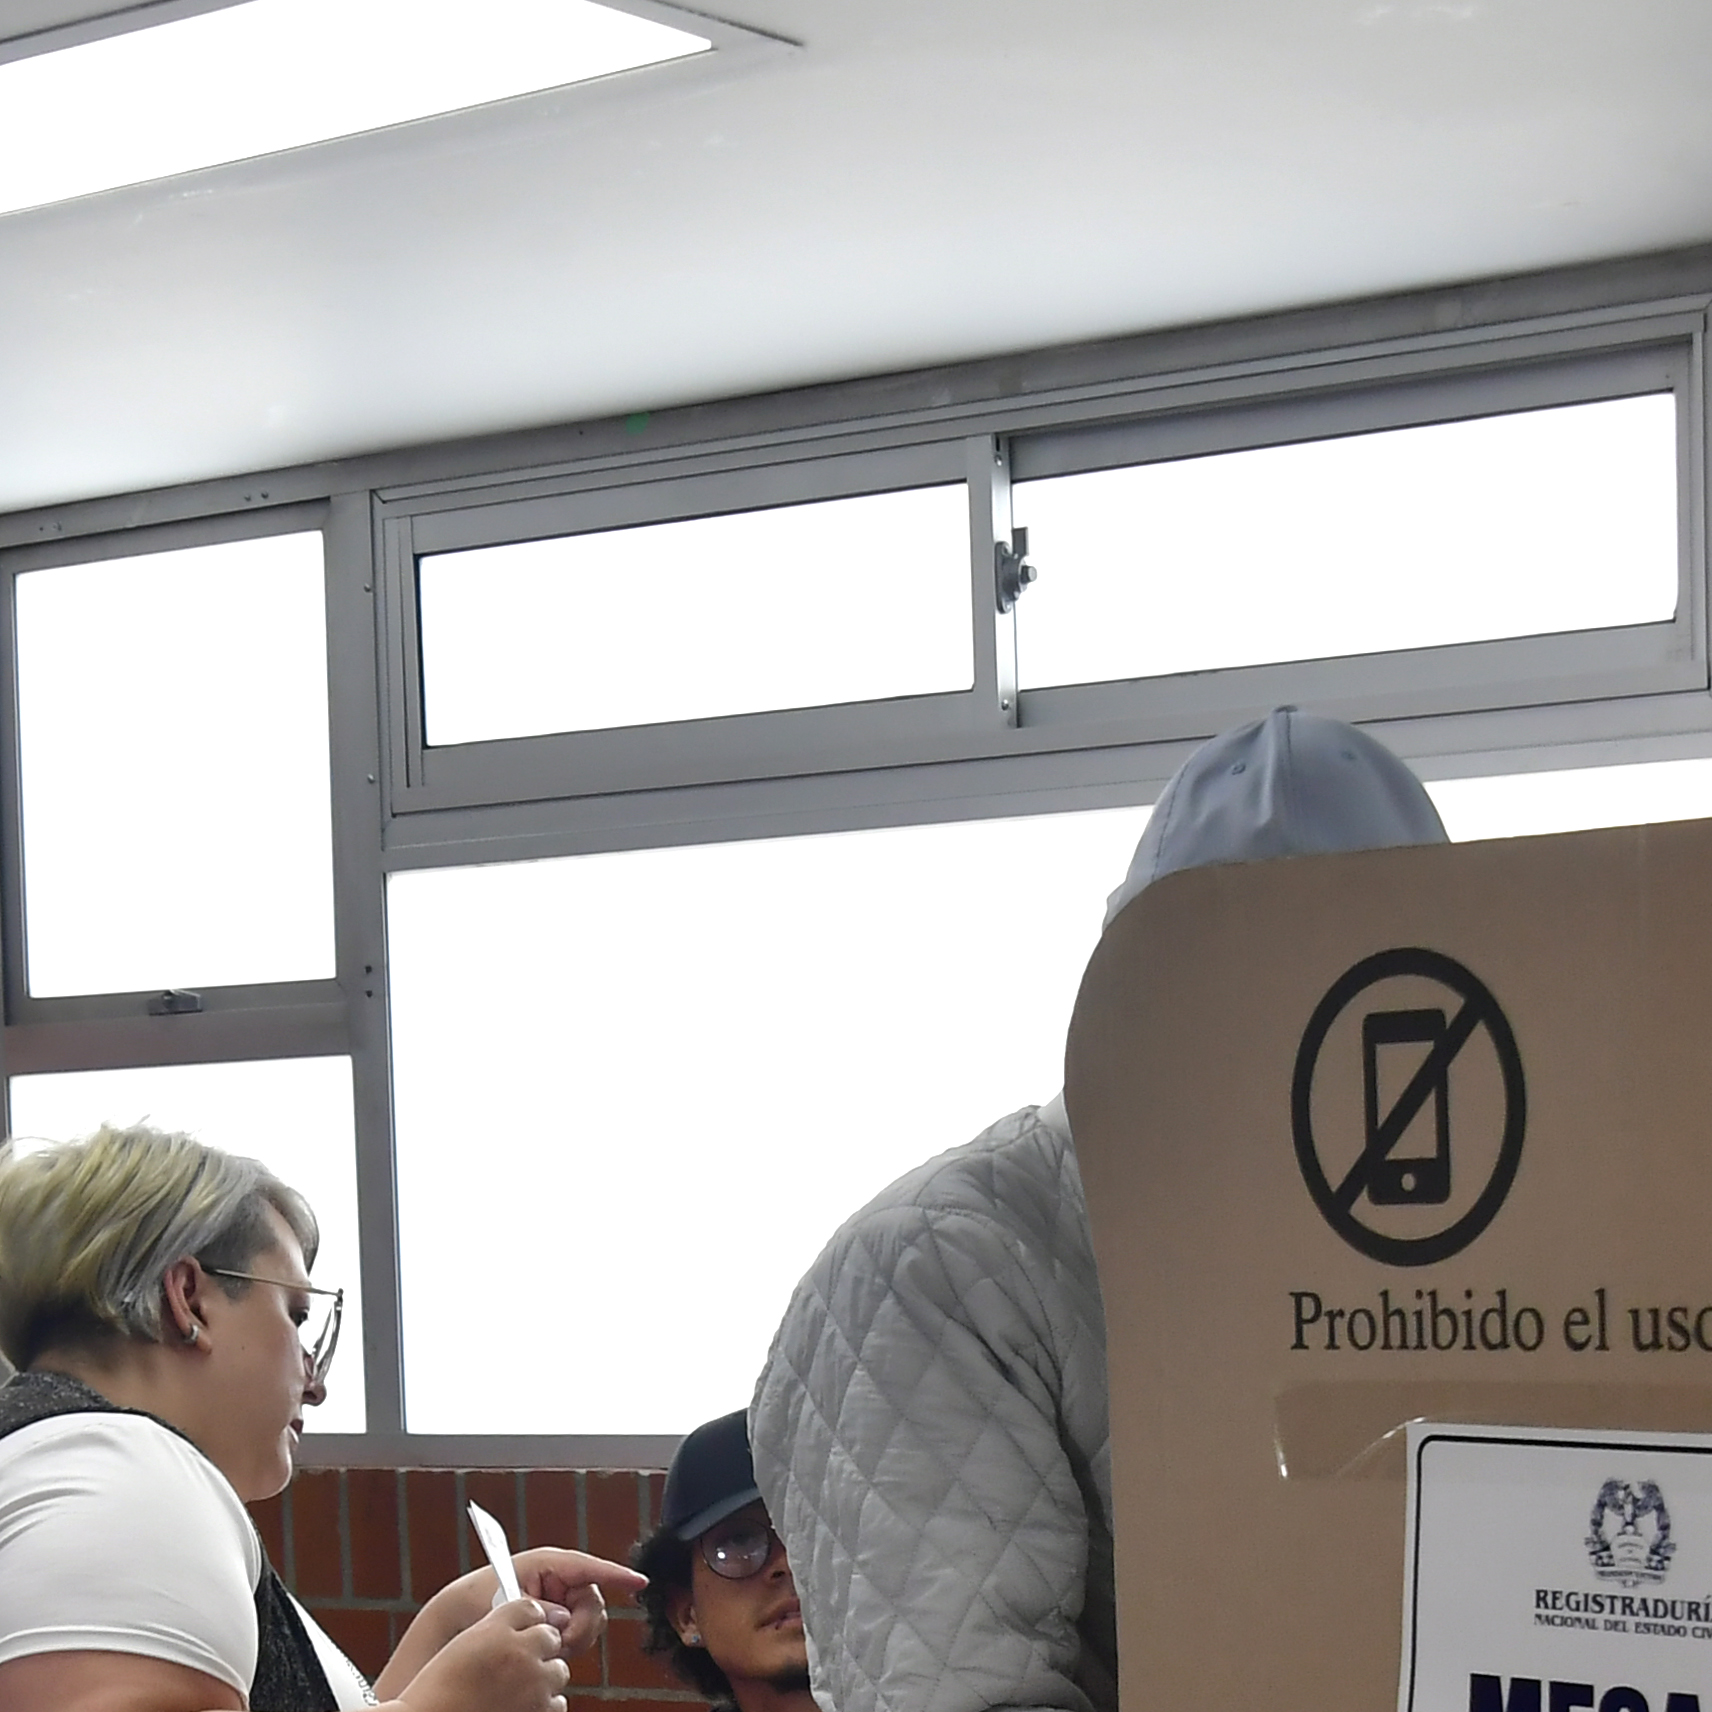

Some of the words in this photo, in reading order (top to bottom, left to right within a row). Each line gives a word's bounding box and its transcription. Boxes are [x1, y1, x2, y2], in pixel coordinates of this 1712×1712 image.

[1288, 1288, 1545, 1352] Prohibido
[1562, 1286, 1610, 1353] el
[1534, 1613, 1600, 1630] NACIONAL
[1603, 1618, 1630, 1633] DEL
[1634, 1621, 1688, 1639] ESTADO
